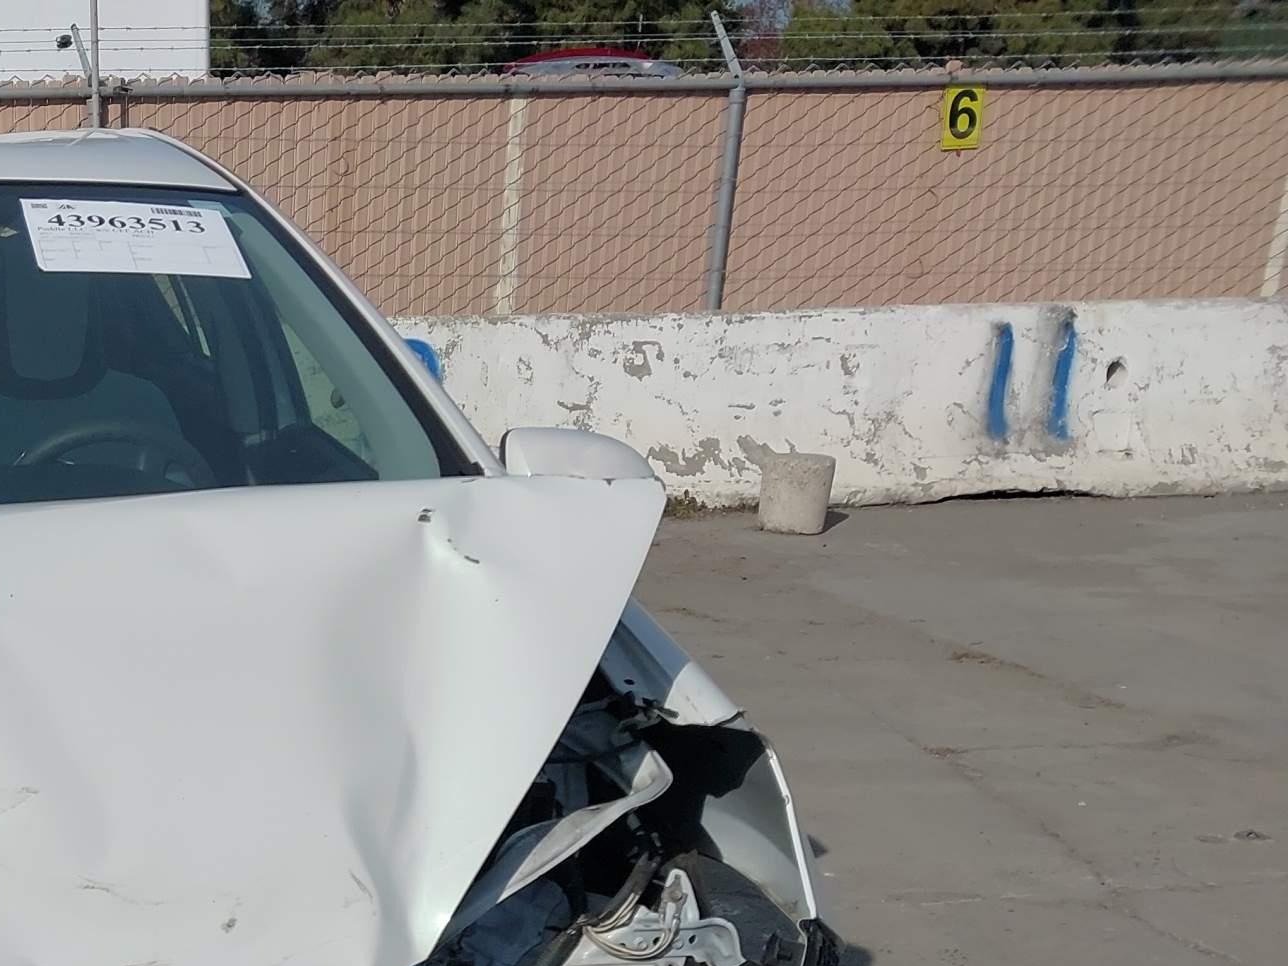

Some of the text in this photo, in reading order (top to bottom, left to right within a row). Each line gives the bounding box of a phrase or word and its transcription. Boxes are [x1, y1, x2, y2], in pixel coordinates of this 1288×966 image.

[949, 89, 978, 139] 6
[47, 214, 206, 233] 43963513
[987, 320, 1077, 440] 11
